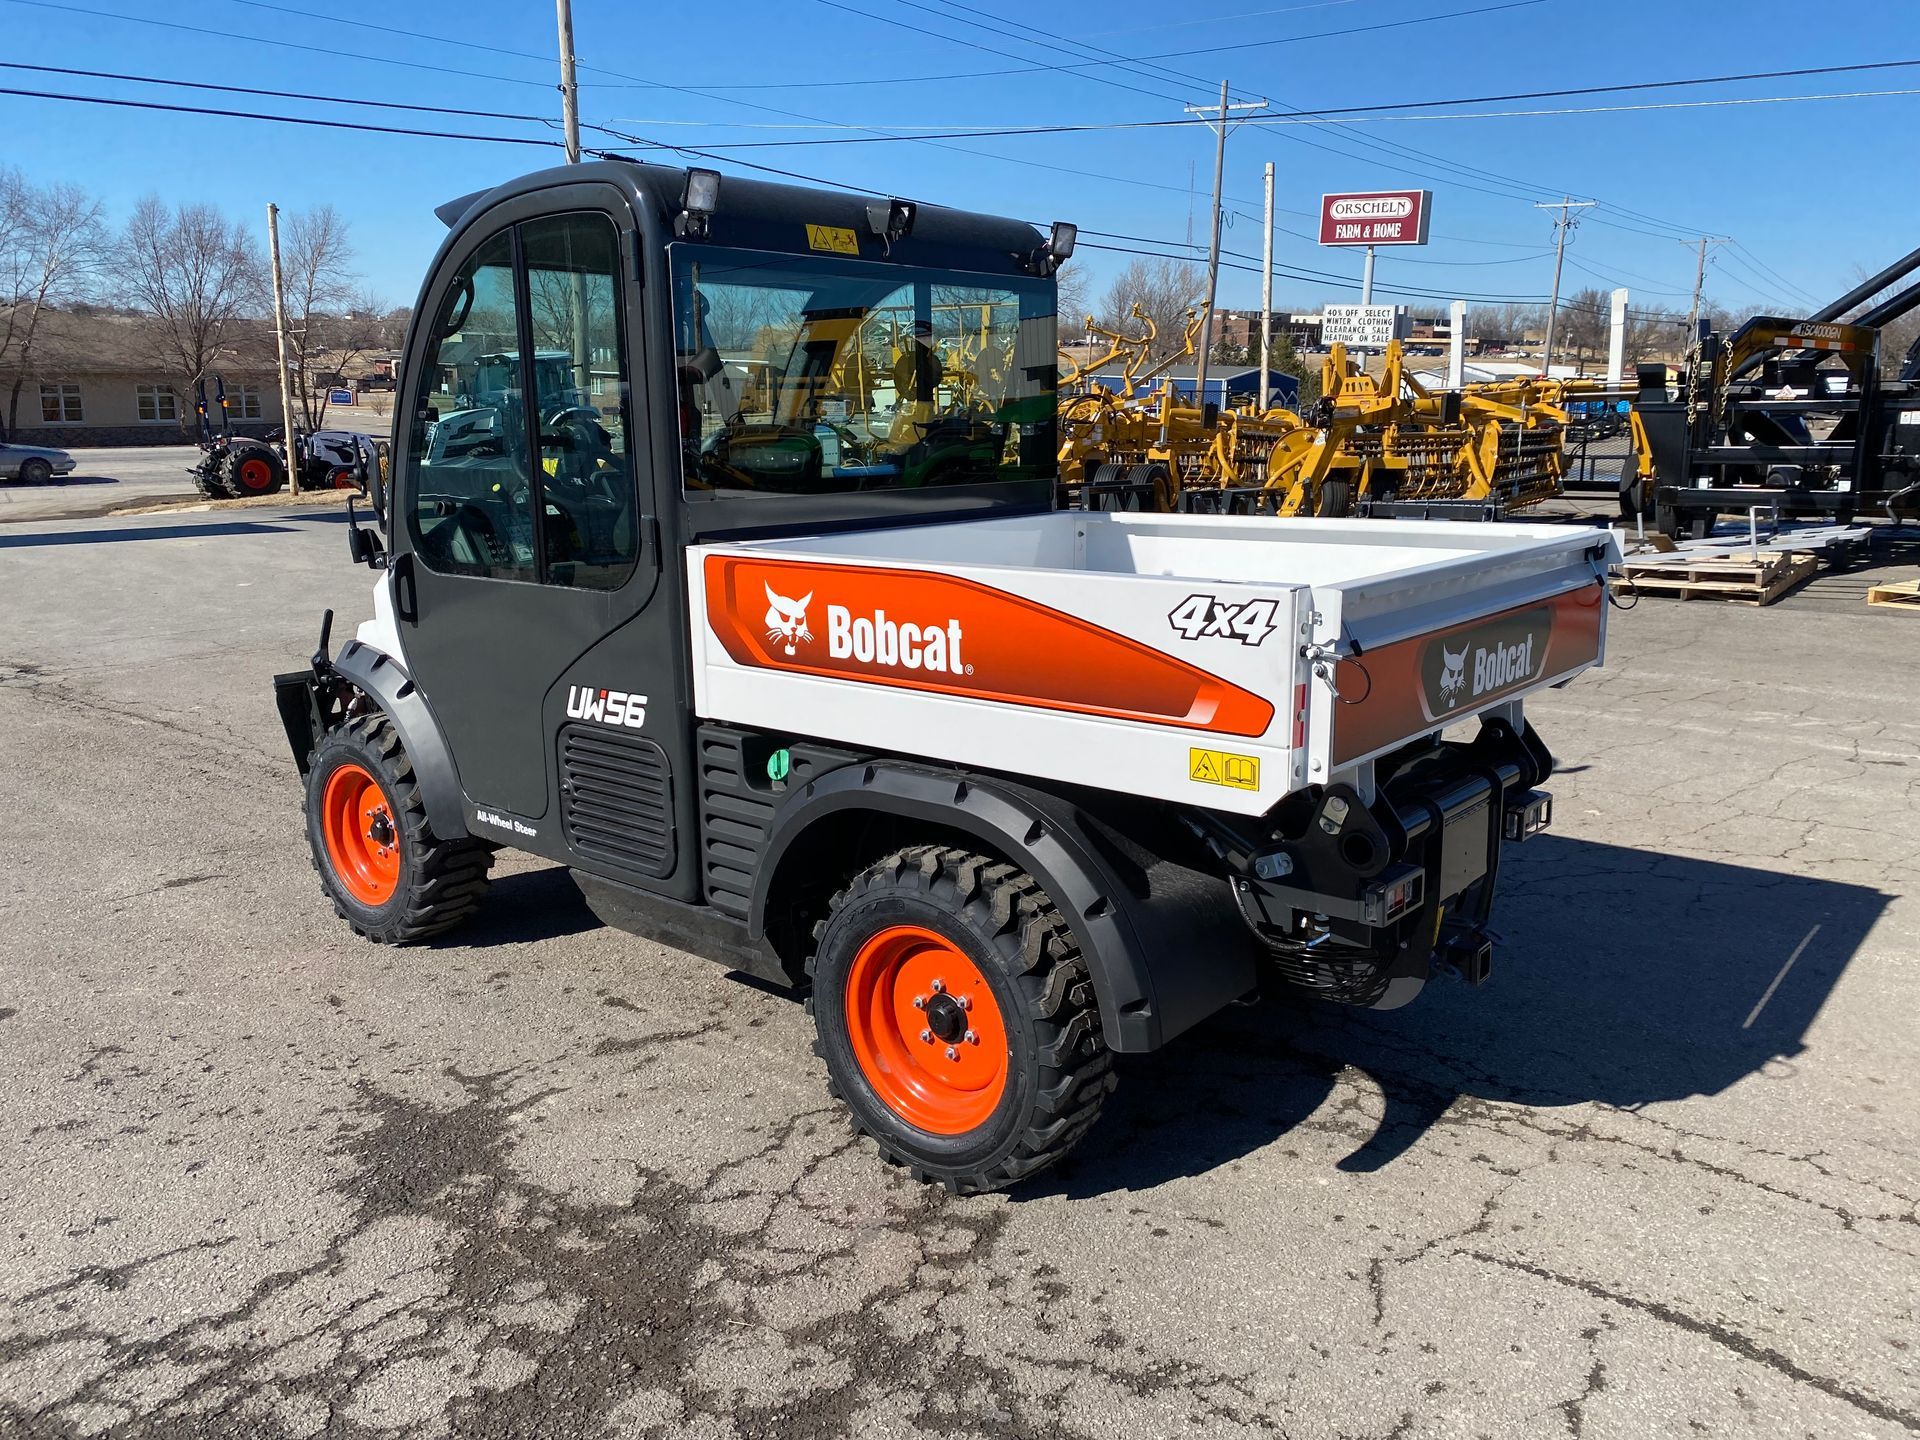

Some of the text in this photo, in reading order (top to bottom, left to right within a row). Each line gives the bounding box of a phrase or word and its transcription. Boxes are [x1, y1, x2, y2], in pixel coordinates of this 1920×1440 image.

[1335, 201, 1406, 215] ORSCHELN
[1335, 223, 1402, 239] FARM & HOME
[1327, 309, 1391, 317] 40% OFF SELECT
[1325, 325, 1390, 334] CLEARANCE SALE
[1326, 317, 1393, 326] WINTER CLOTHING
[1324, 333, 1390, 343] HEATING ON SALE
[1168, 594, 1279, 647] 4x4
[827, 604, 963, 675] Bobcat
[1472, 633, 1533, 696] Bobcat
[566, 685, 648, 728] UW56
[477, 810, 537, 837] All-Wheel Steer
